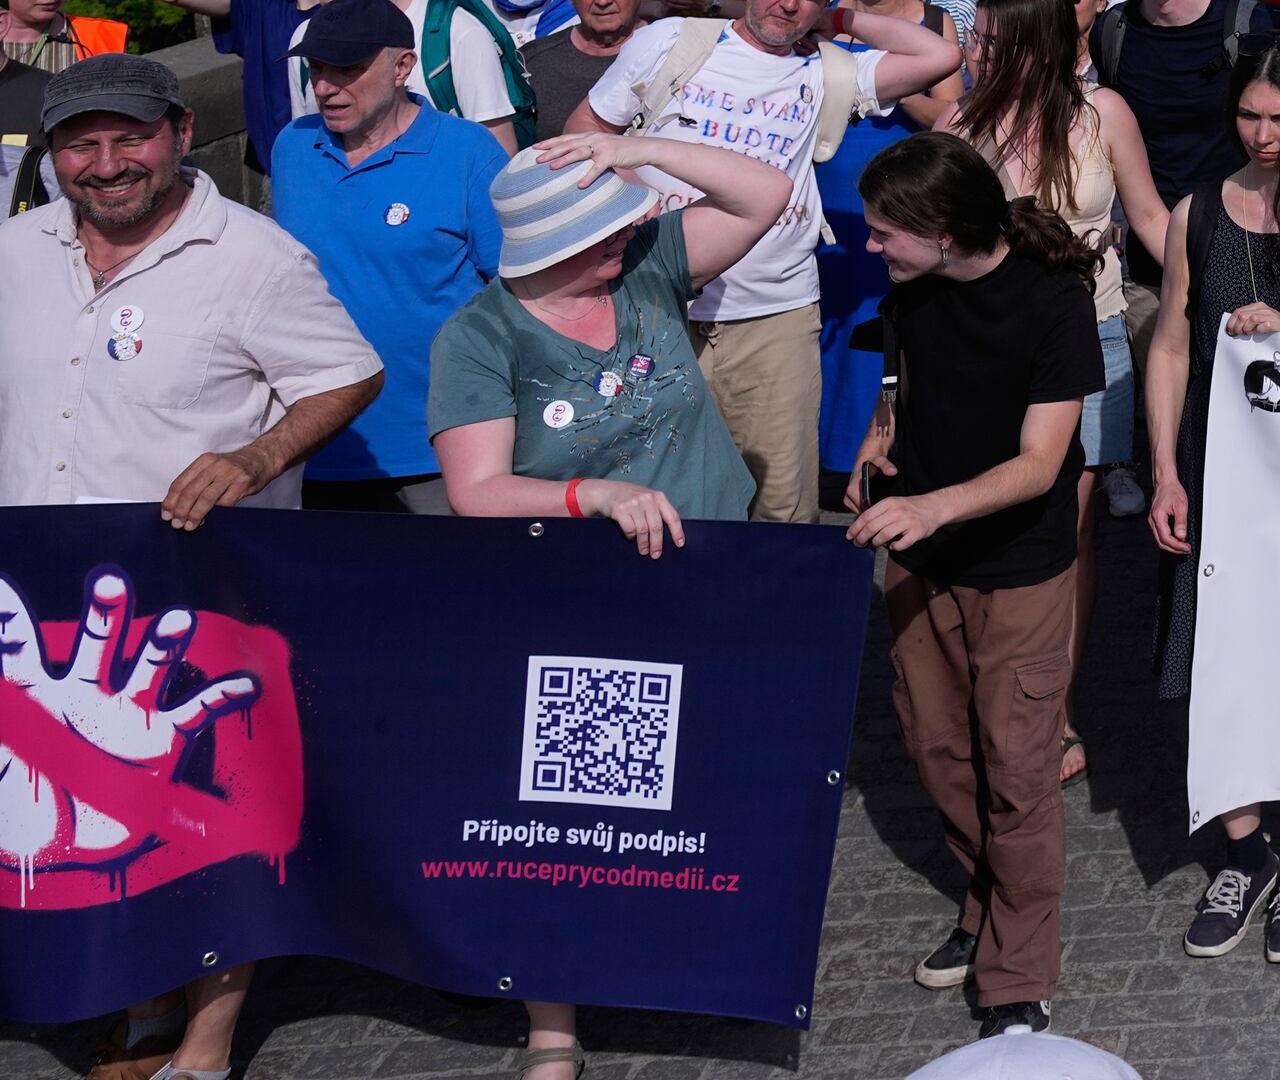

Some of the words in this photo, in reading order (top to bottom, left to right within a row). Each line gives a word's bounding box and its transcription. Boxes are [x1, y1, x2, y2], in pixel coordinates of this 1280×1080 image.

[462, 819, 560, 848] Připojte
[565, 822, 614, 853] svůj
[618, 829, 707, 857] podpis!
[421, 859, 740, 893] www.ruceprycodmedii.cz
